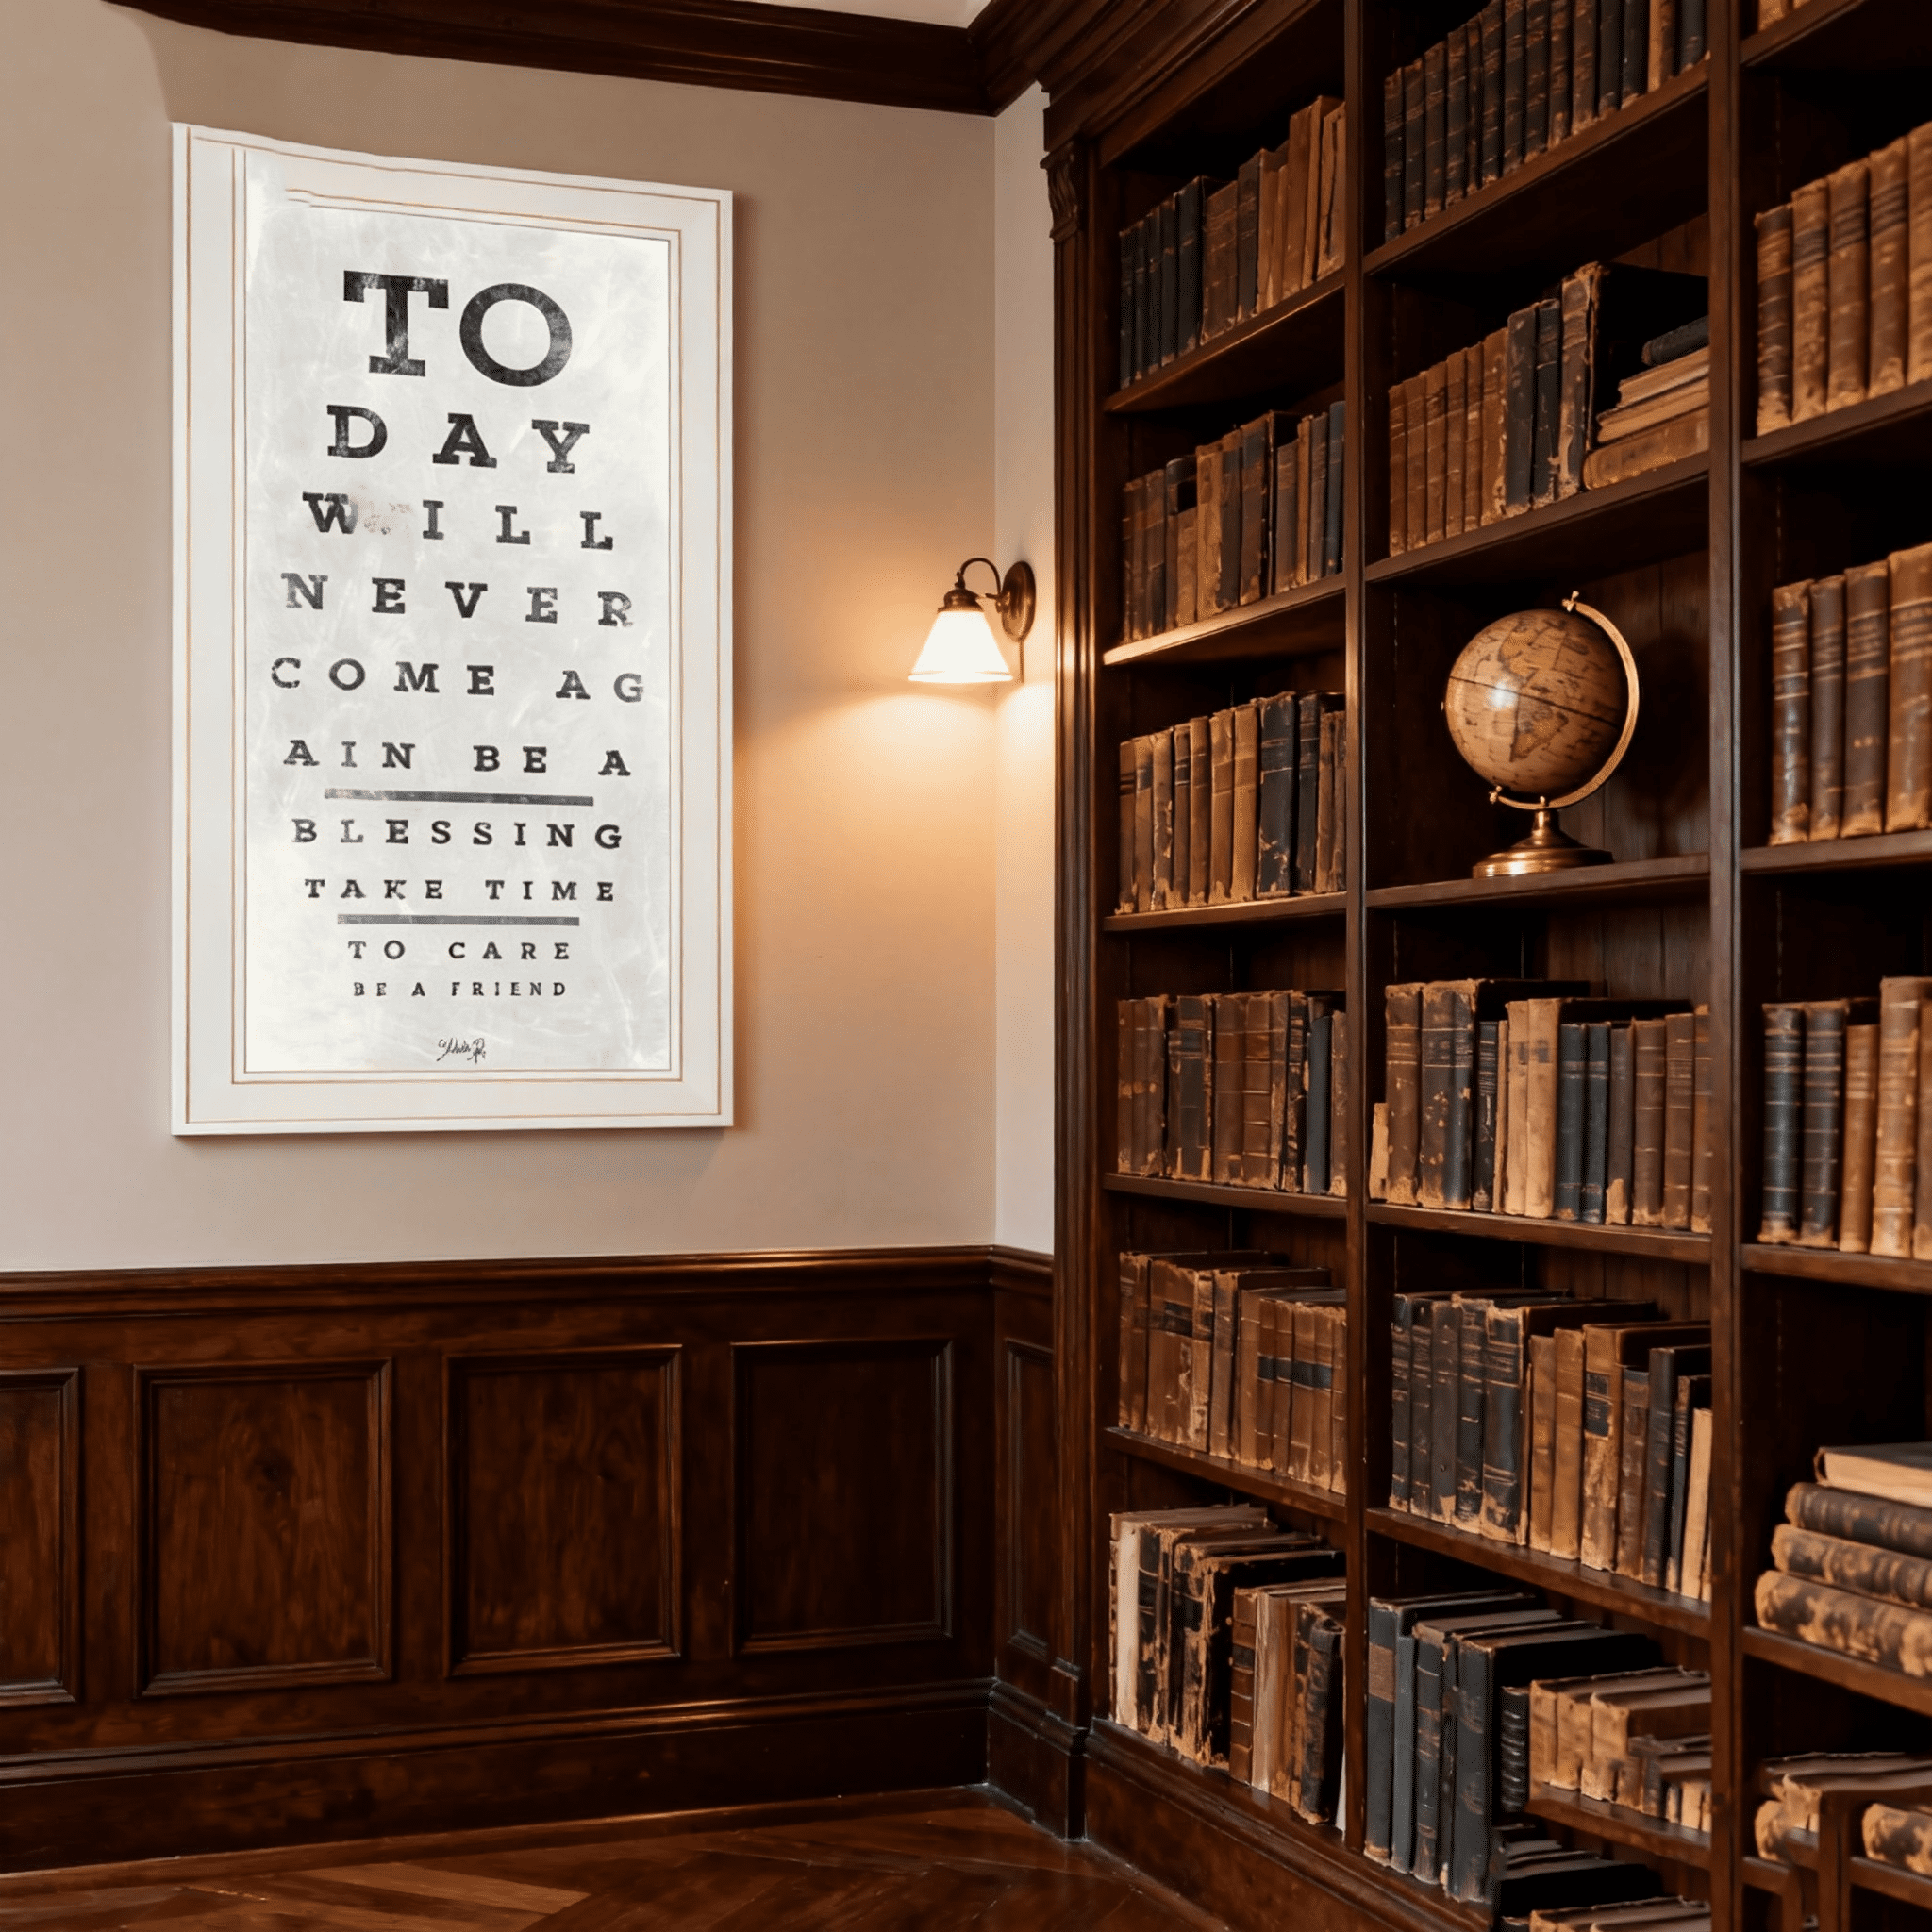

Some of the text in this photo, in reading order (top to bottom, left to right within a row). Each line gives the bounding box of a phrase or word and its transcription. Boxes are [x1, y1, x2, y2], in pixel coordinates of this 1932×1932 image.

[343, 270, 573, 388] TO
[326, 404, 591, 474] DAY
[302, 491, 613, 551] WILL
[281, 573, 633, 627] NEVER
[271, 657, 644, 703] COME AG
[283, 740, 631, 776] AIN BE A
[291, 819, 623, 850] BLESSING
[305, 879, 614, 902] TAKE TIME
[348, 940, 570, 960] TO CARE
[354, 982, 566, 997] BE A FRIEND
